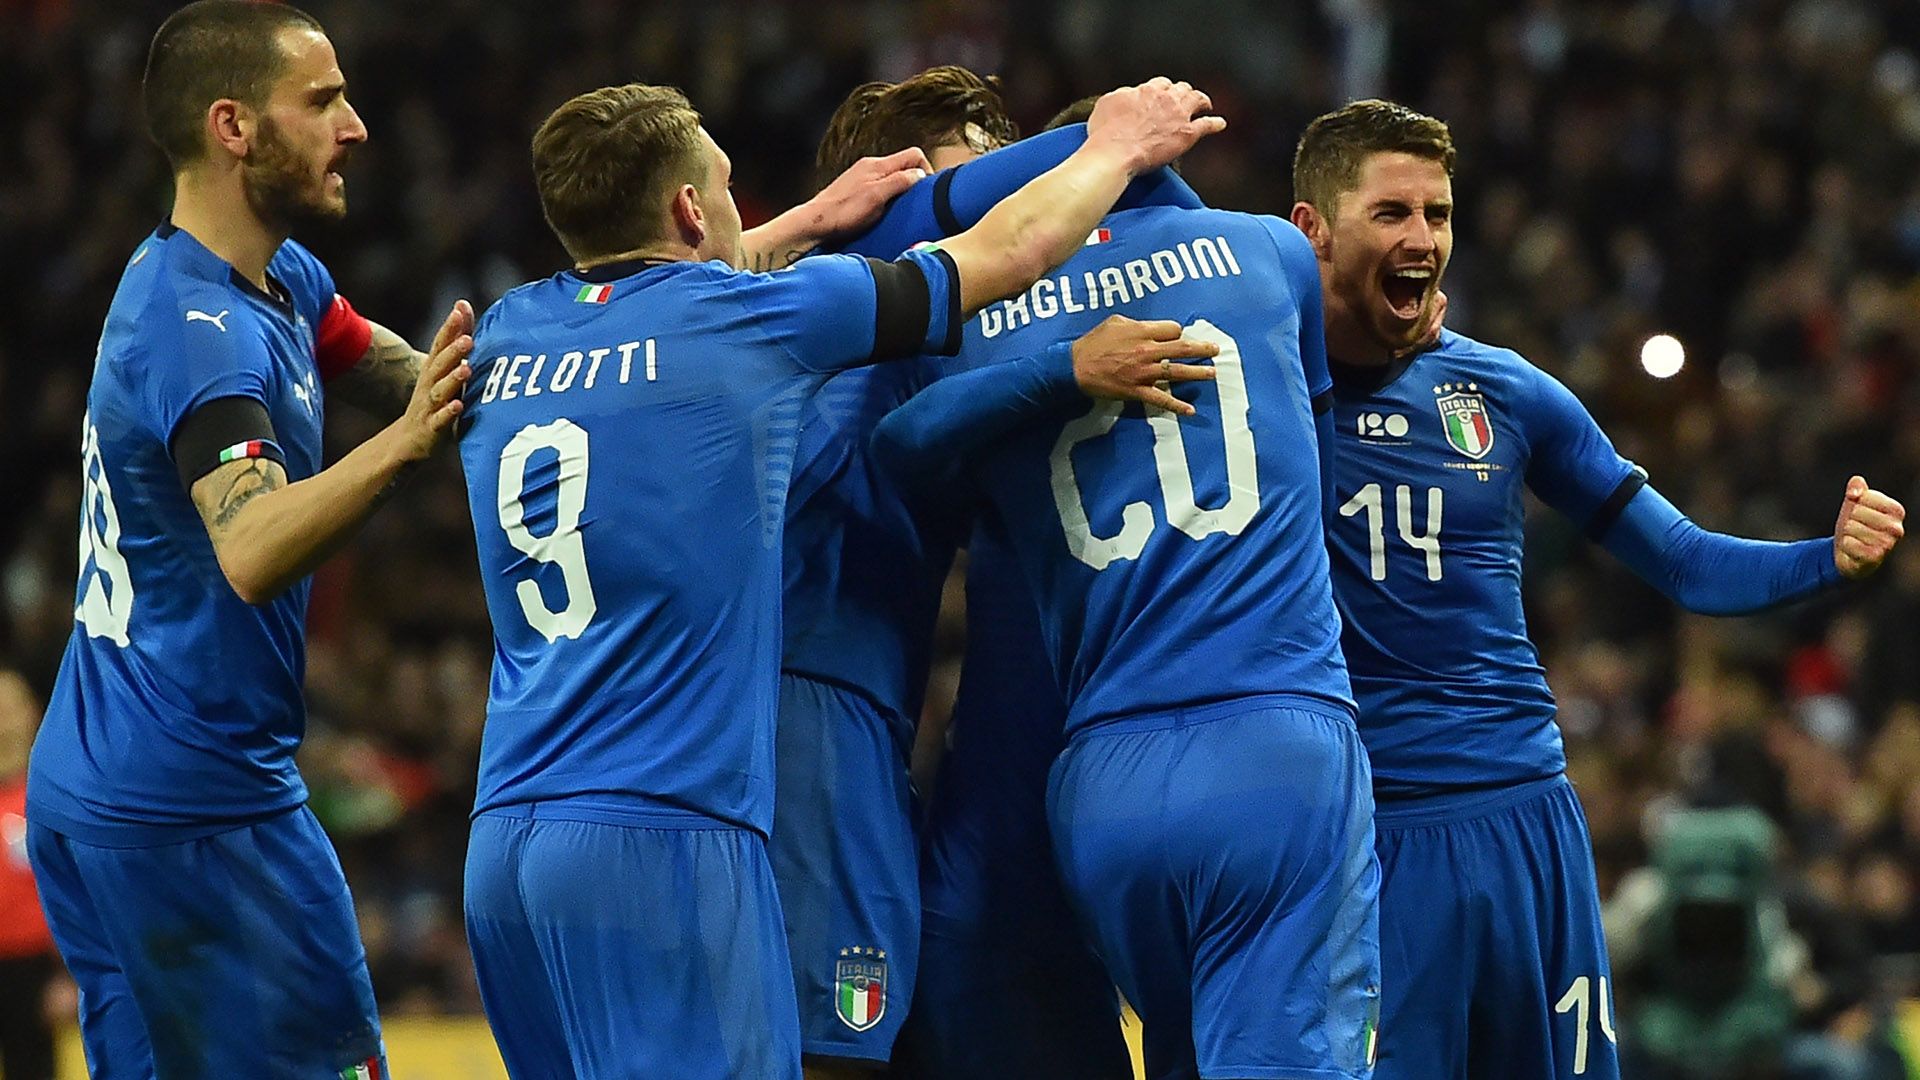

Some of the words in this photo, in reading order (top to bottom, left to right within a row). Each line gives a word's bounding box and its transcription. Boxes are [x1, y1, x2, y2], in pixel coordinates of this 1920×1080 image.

[979, 236, 1242, 338] GAGLIARDINI
[481, 338, 657, 404] BELOTTI
[1442, 399, 1480, 411] ITALIA
[1050, 319, 1261, 571] 20
[1357, 413, 1409, 437] 120
[498, 417, 597, 644] 9
[1339, 483, 1443, 581] 14
[841, 964, 883, 977] ITALIA
